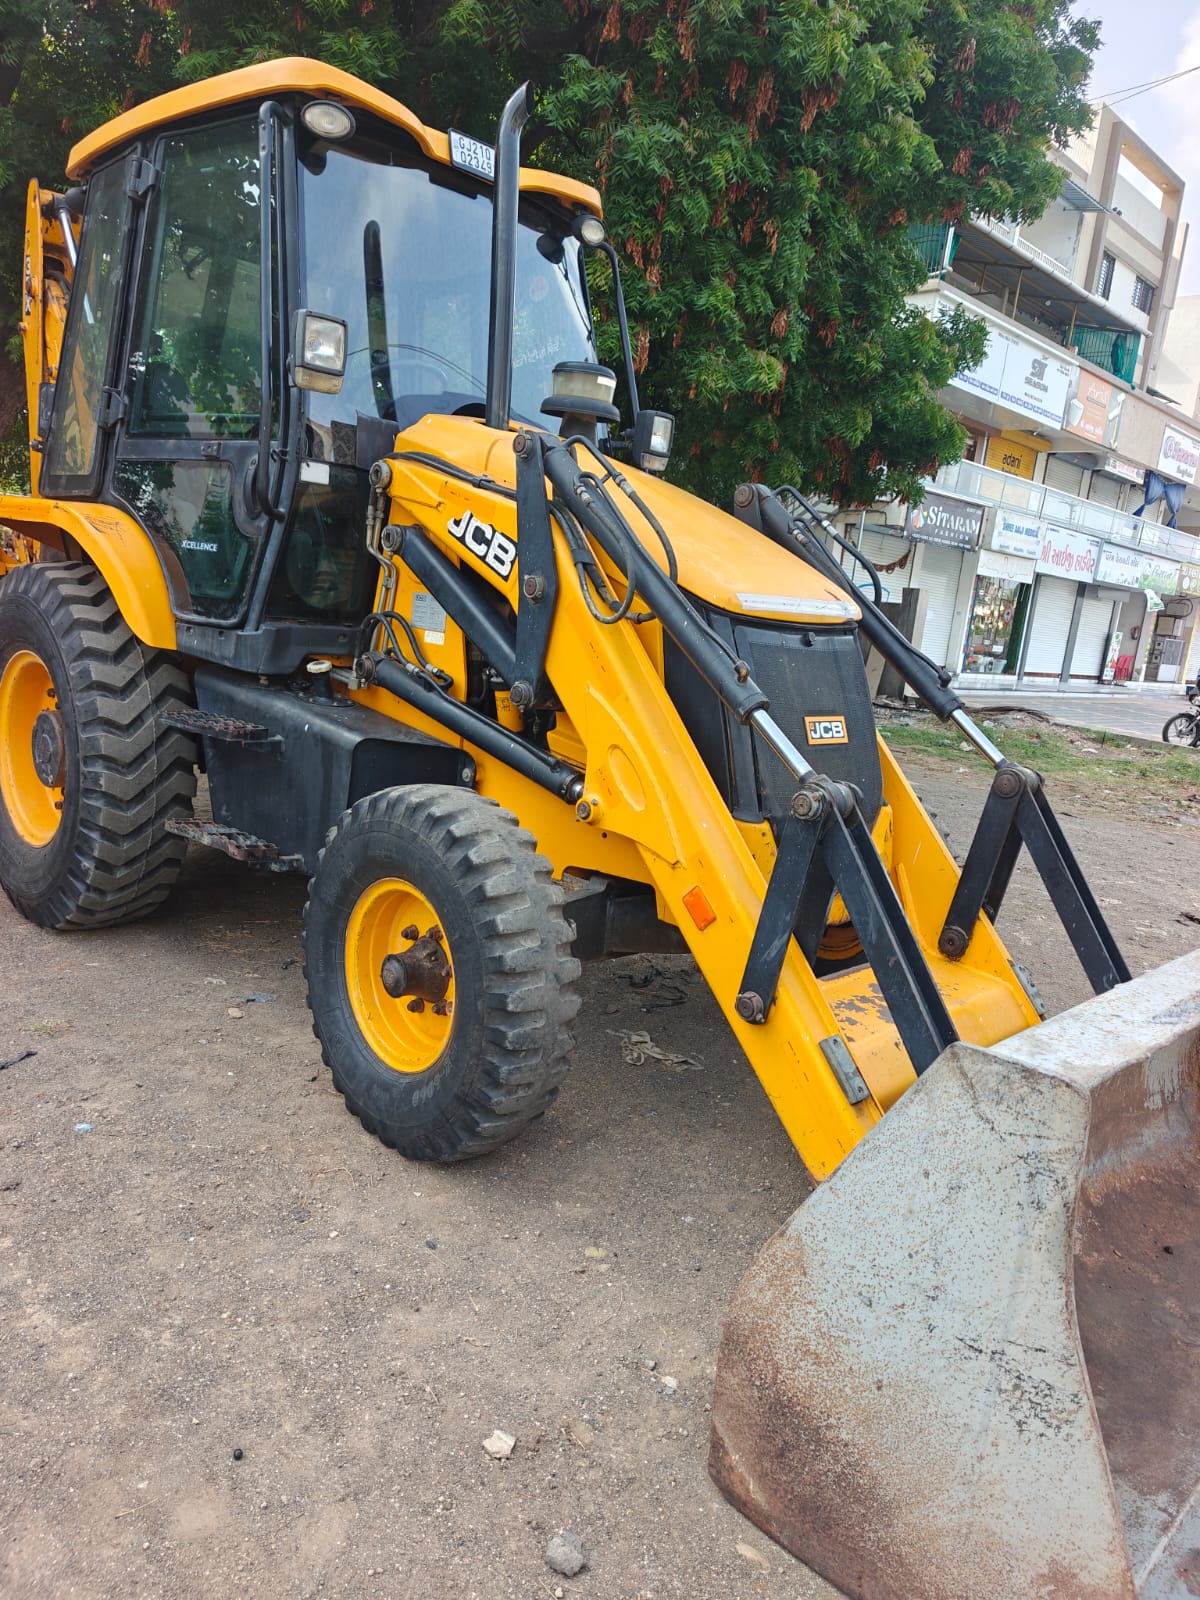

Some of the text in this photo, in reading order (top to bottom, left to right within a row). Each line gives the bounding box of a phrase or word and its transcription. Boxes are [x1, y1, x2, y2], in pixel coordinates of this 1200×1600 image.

[1002, 453, 1023, 470] adani
[181, 539, 219, 552] XCELLENCE
[448, 509, 517, 577] JCB
[811, 721, 844, 739] JCB
